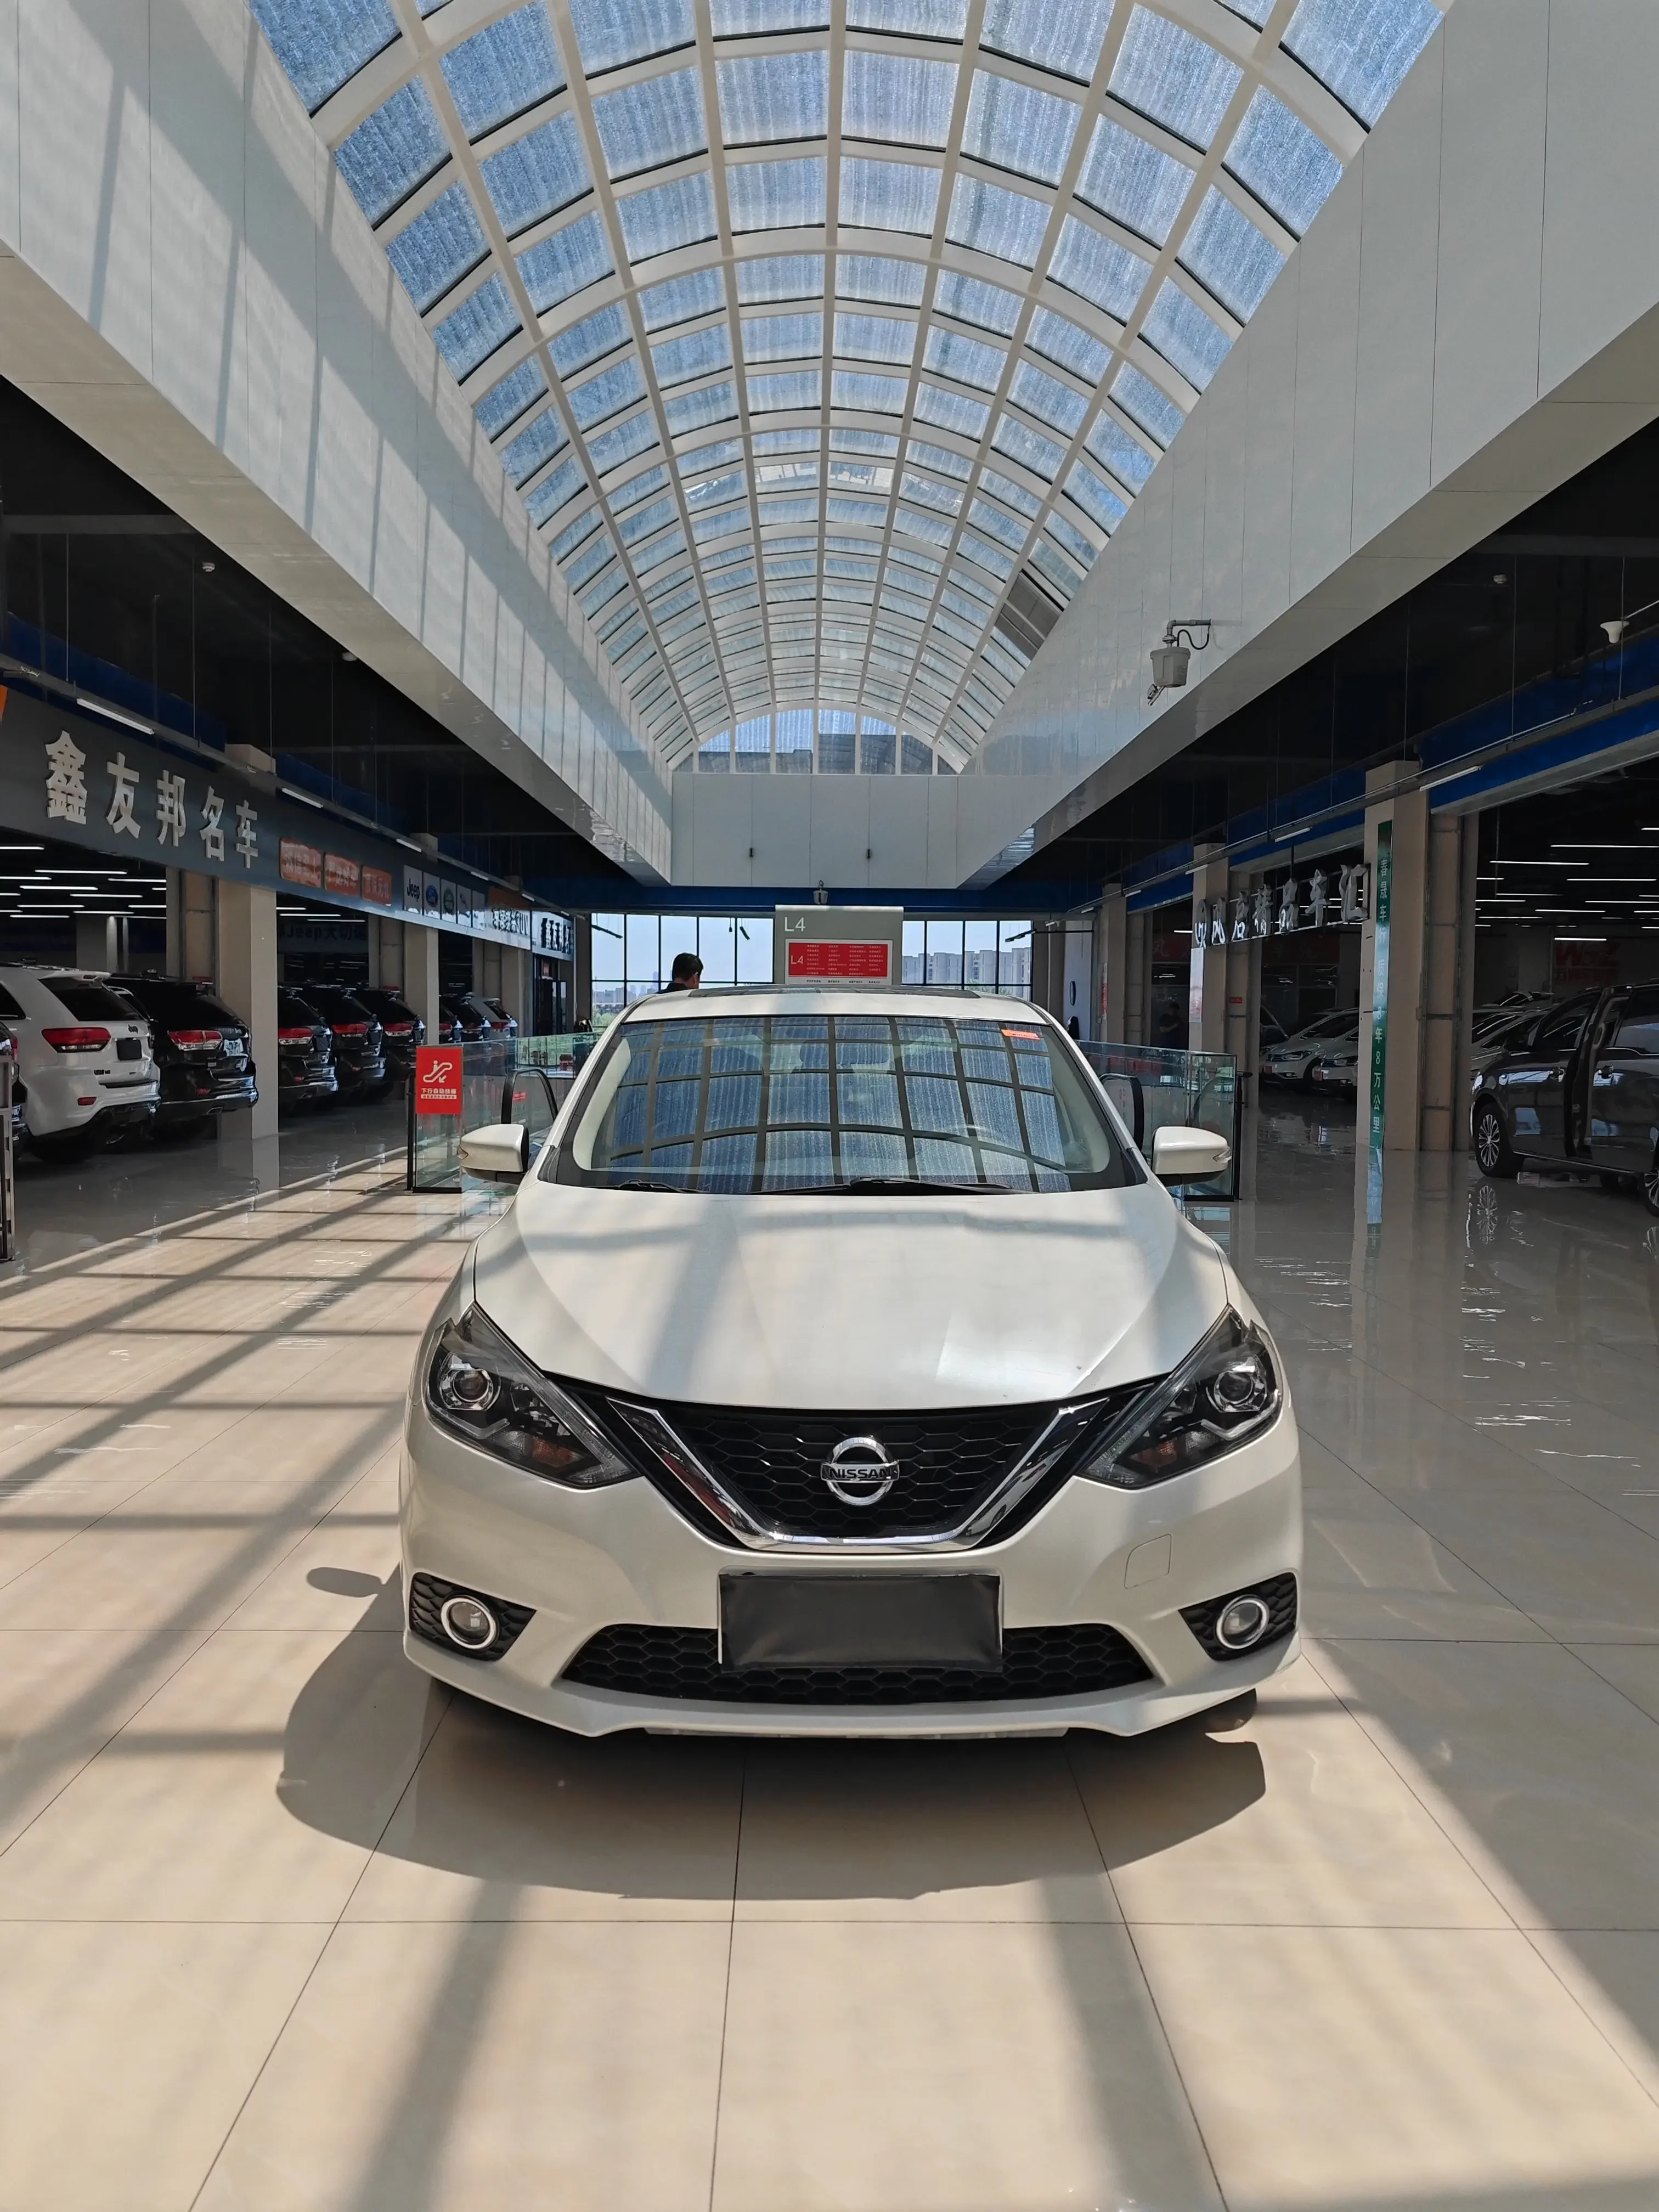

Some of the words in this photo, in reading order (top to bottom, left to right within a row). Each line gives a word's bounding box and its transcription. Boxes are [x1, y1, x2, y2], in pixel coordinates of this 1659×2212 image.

[45, 730, 259, 869] 鑫友邦名车
[407, 878, 420, 902] Jeep
[784, 916, 806, 932] L4
[791, 955, 804, 965] L4
[830, 1468, 891, 1480] NISSAN
